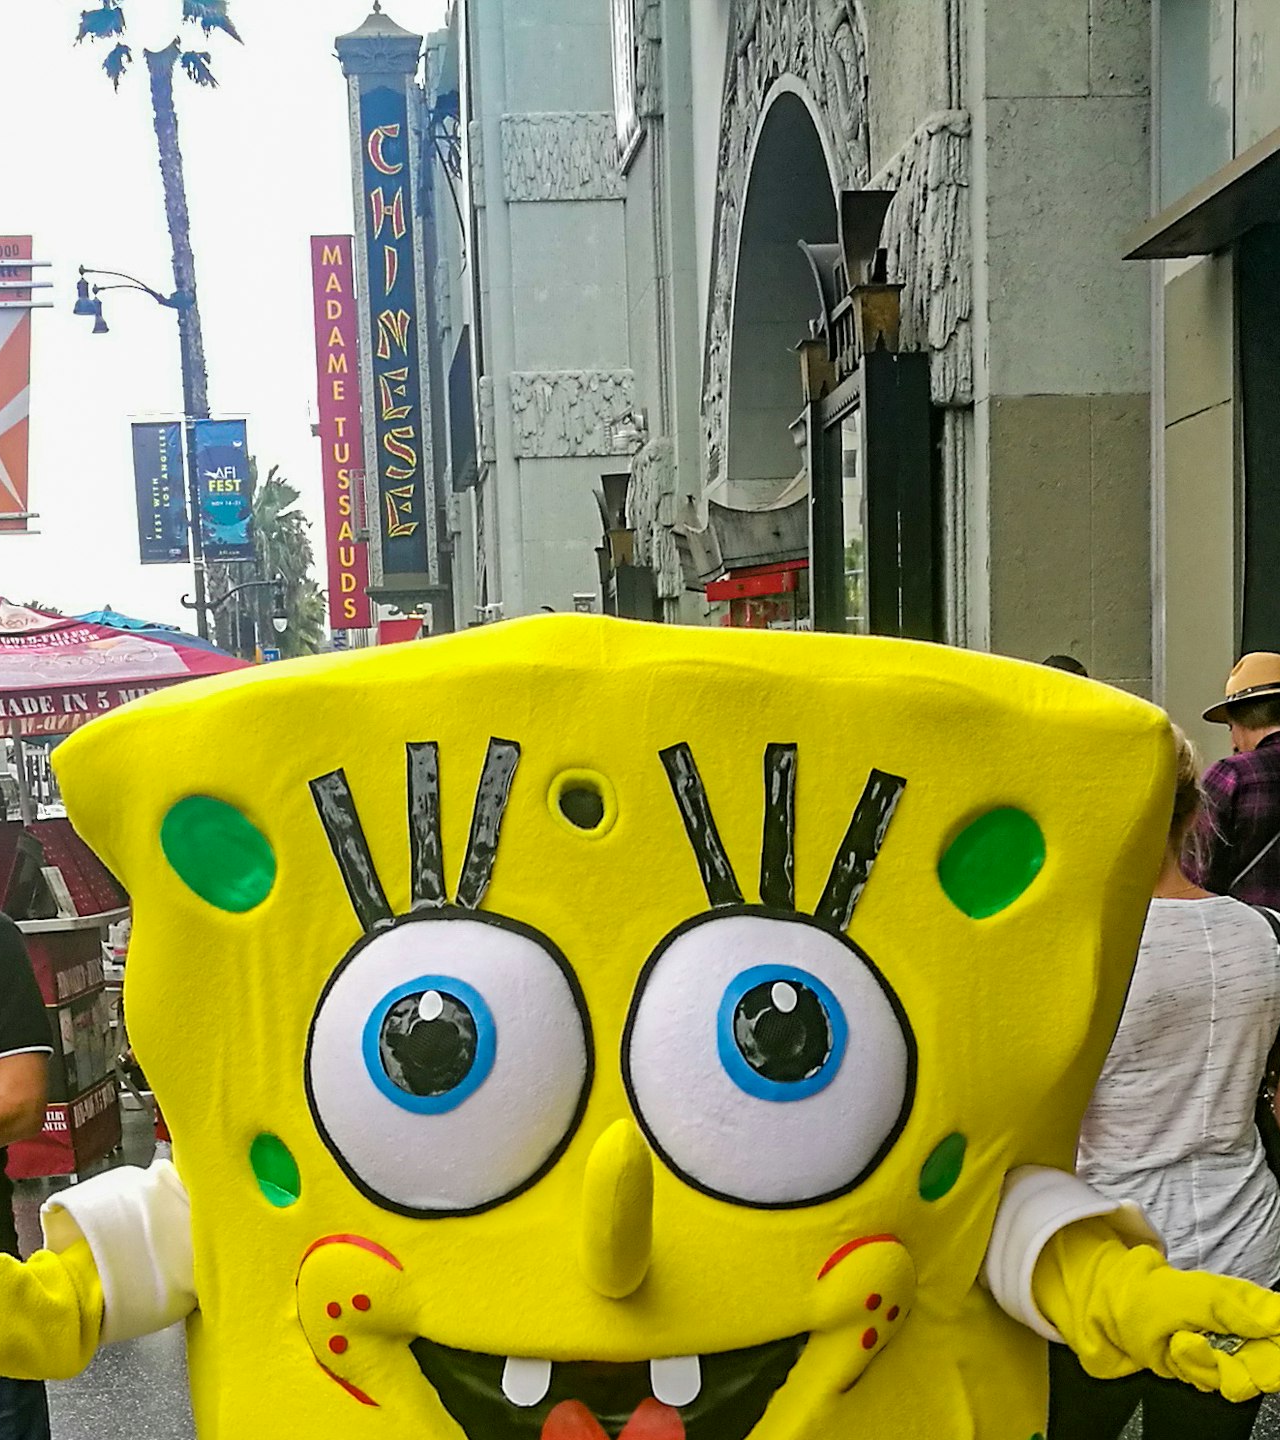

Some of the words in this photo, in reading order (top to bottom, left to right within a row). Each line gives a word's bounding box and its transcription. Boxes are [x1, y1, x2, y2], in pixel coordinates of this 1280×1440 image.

[321, 245, 348, 401] MADAME
[368, 123, 419, 538] CHINESE
[159, 428, 169, 480] ANGELES
[208, 479, 242, 492] FEST
[211, 466, 237, 479] AFI
[152, 477, 160, 508] WITH
[162, 486, 170, 508] LOS
[154, 514, 162, 539] FEST
[333, 417, 357, 619] TUSSAUDS
[62, 693, 88, 713] IN
[97, 690, 110, 709] 5
